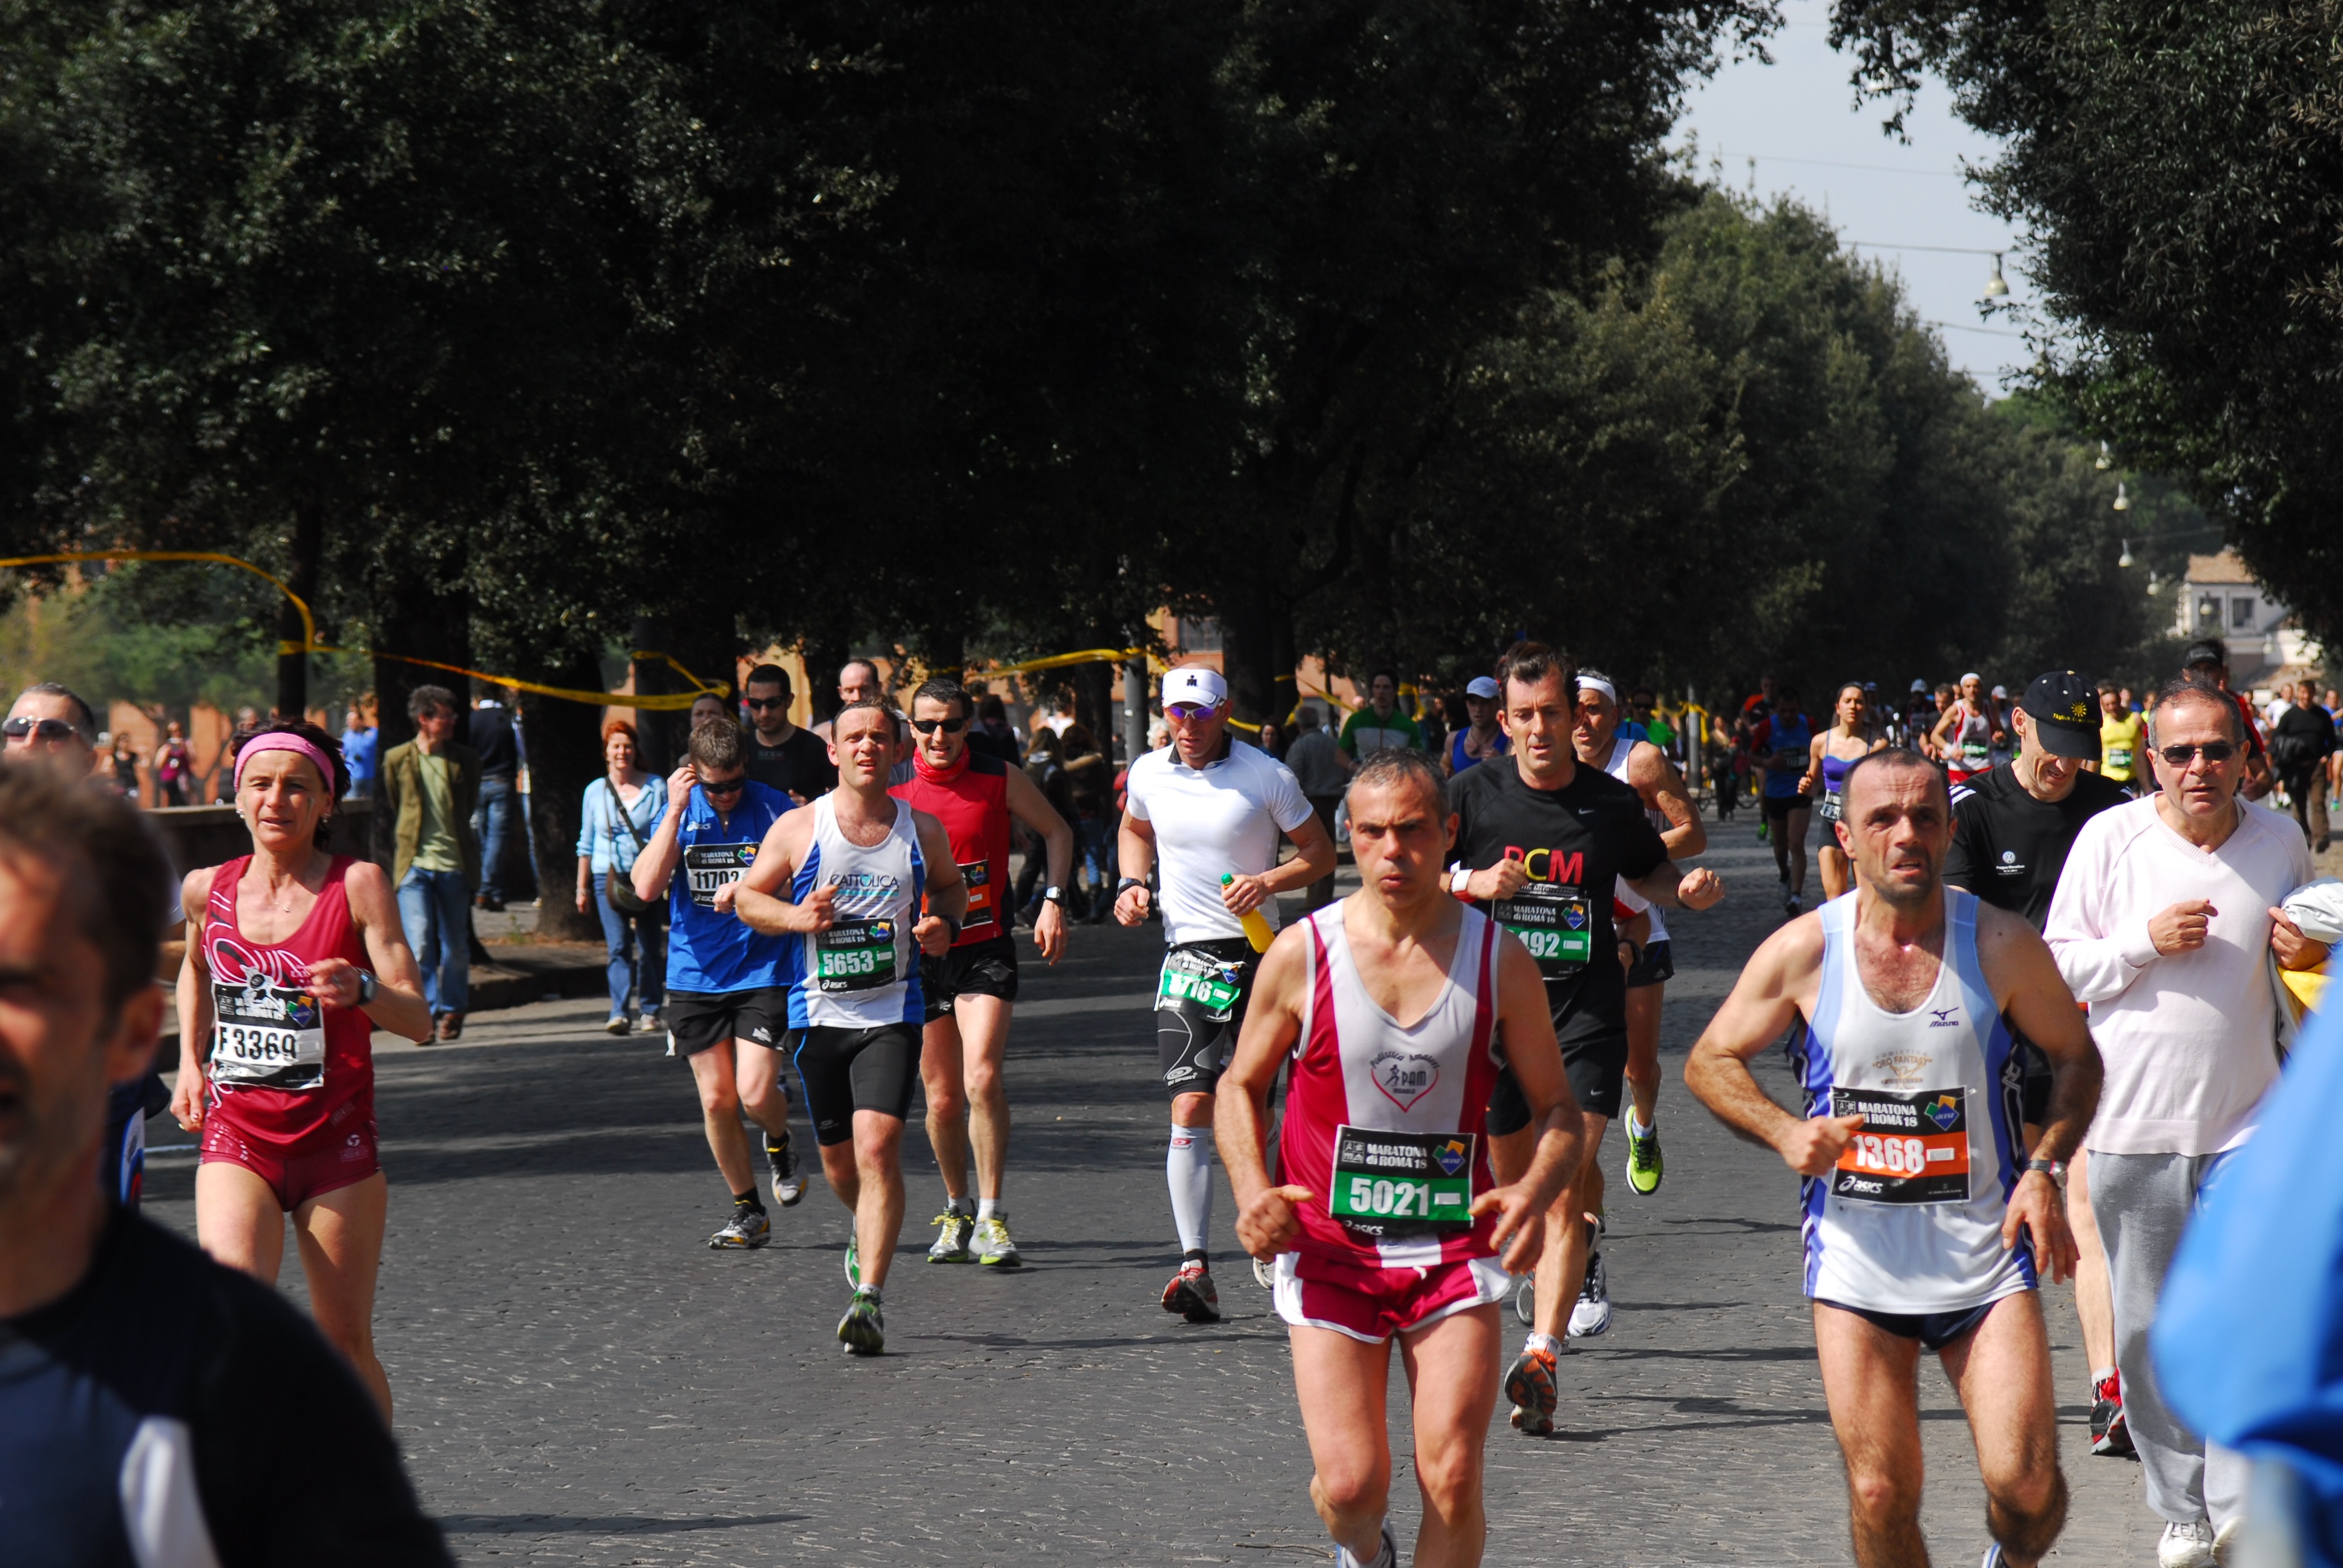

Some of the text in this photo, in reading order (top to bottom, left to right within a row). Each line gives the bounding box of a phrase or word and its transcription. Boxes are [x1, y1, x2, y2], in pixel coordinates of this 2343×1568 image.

[830, 874, 900, 888] CATTOLICA
[1513, 905, 1556, 916] MARATONA
[1522, 913, 1545, 923] ROMA
[828, 928, 865, 937] MARATONA
[822, 950, 874, 976] 5653
[1876, 1058, 1893, 1069] ORO
[1858, 1102, 1917, 1116] MARATONA
[1871, 1114, 1903, 1126] ROMA
[1903, 1117, 1918, 1127] 18
[1366, 1143, 1427, 1158] MARATONA
[1852, 1134, 1925, 1174] 1368
[1366, 1155, 1427, 1169] di ROMA 18
[1854, 1180, 1883, 1194] asics
[1349, 1177, 1429, 1216] 5021
[1352, 1225, 1384, 1235] asics
